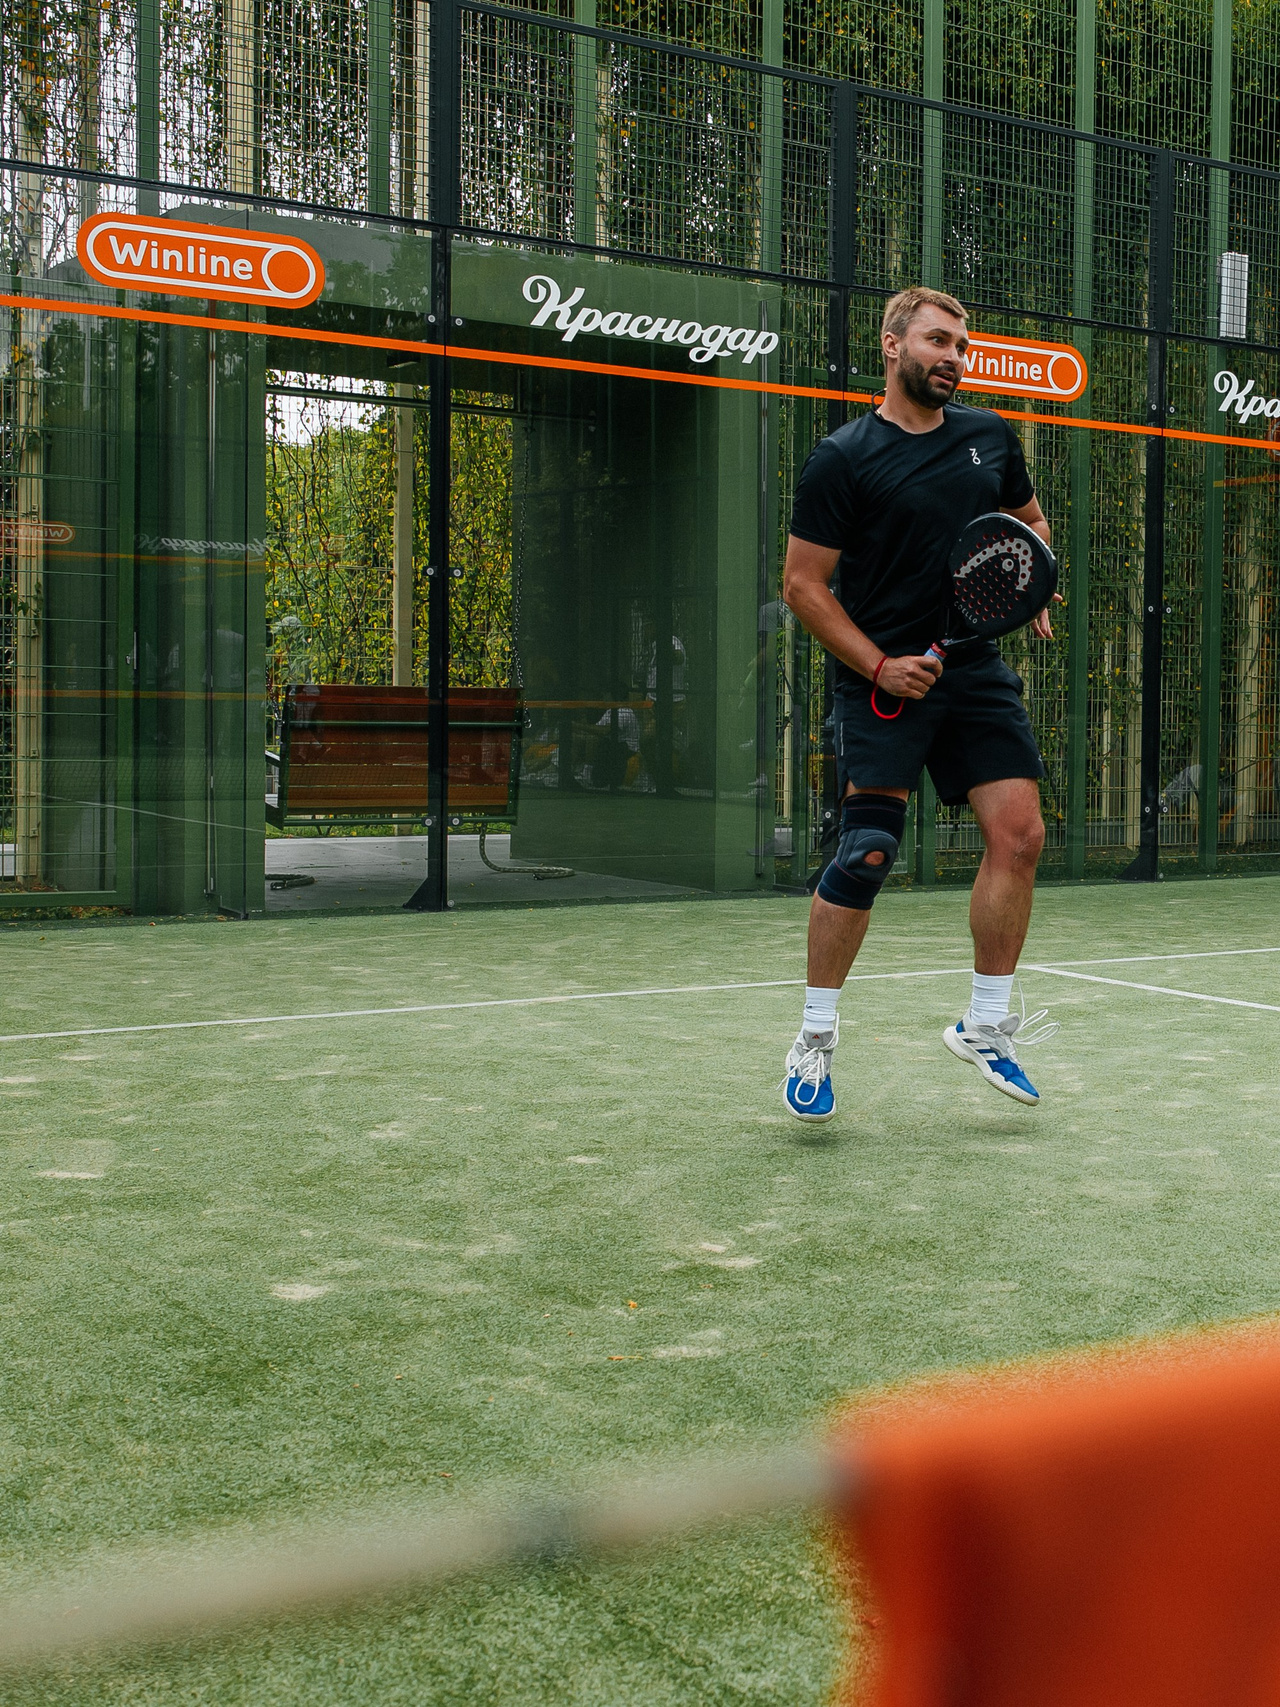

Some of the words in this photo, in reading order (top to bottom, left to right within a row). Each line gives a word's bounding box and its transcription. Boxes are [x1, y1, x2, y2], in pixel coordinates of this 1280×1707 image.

[108, 235, 253, 280] Winline
[522, 275, 779, 364] Краснодар
[954, 601, 978, 624] COELLO
